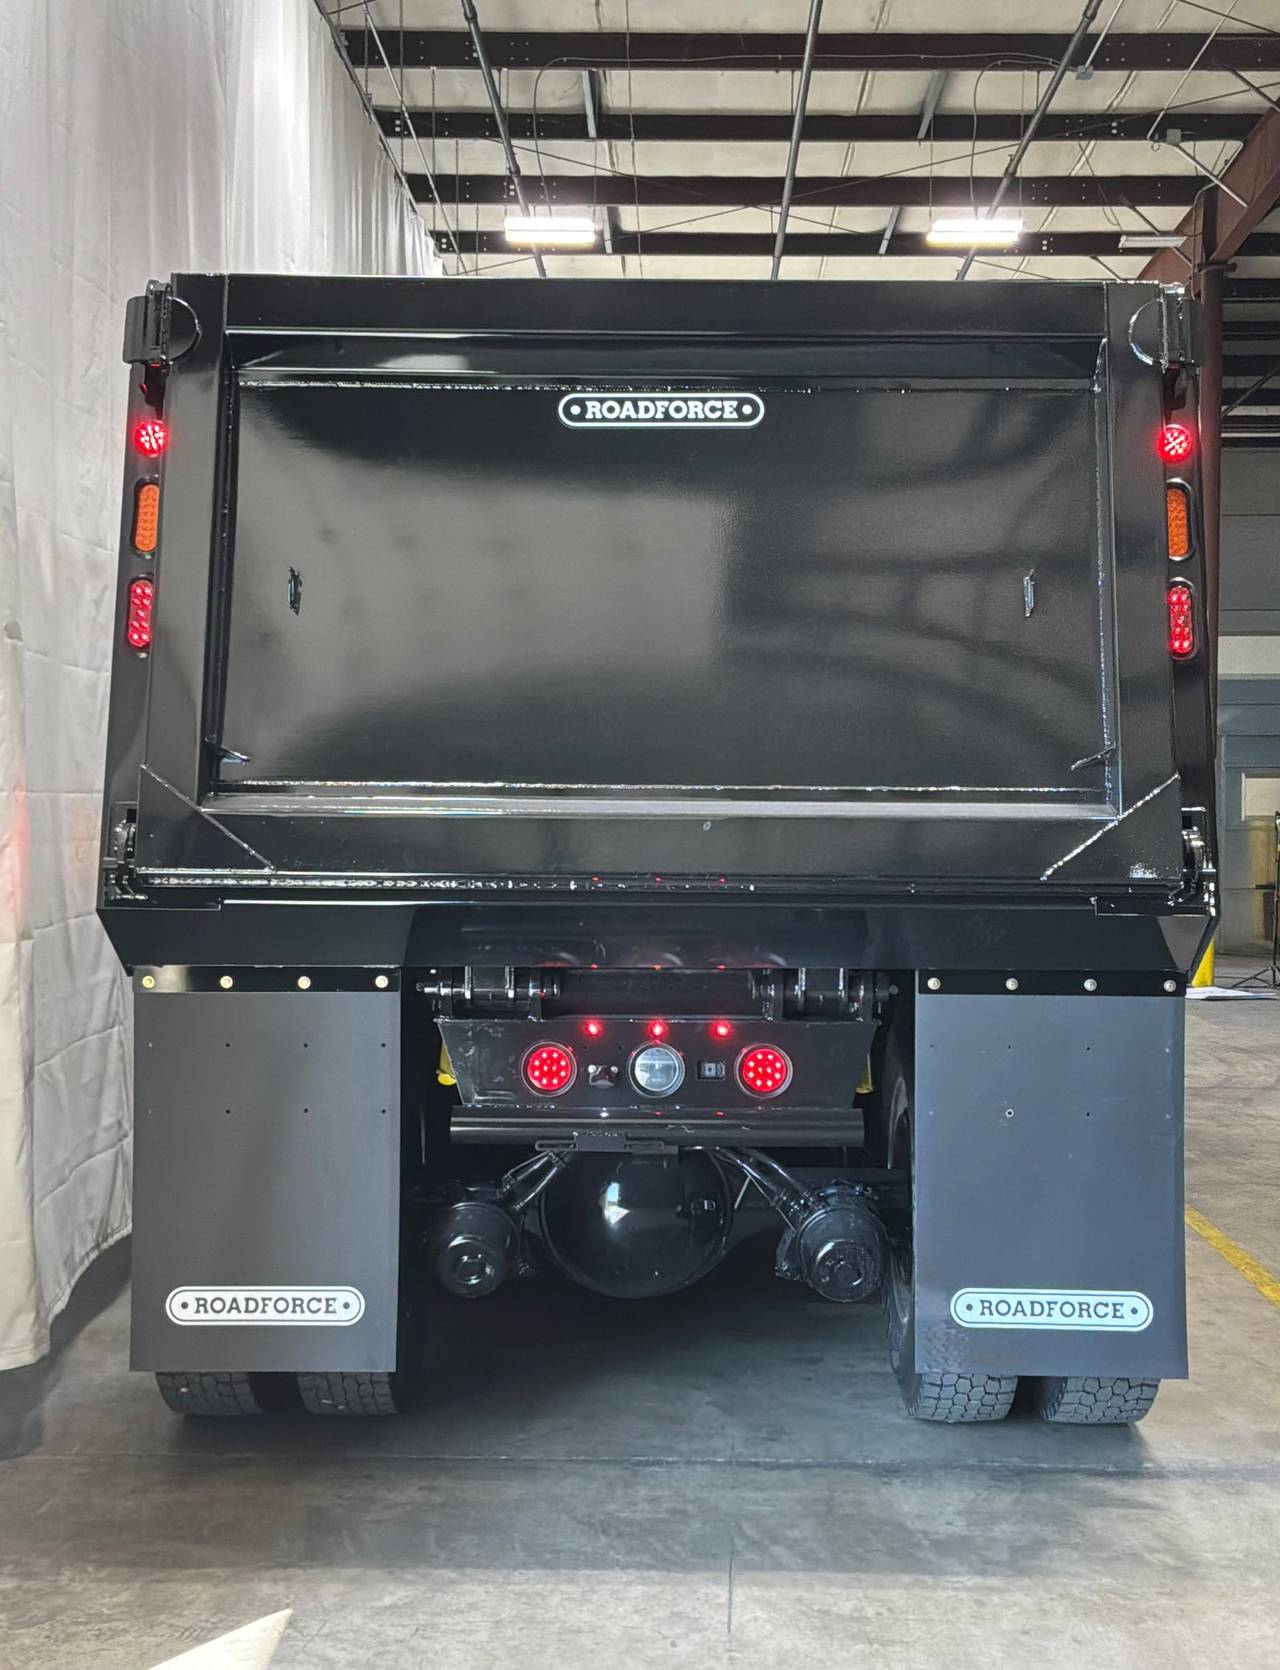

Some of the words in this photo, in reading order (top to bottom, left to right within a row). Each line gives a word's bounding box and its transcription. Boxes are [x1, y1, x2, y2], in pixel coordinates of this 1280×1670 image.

[584, 400, 739, 419] ROADFORCE
[194, 1297, 338, 1314] ROADFORCE
[979, 1299, 1125, 1319] ROADFORCE
